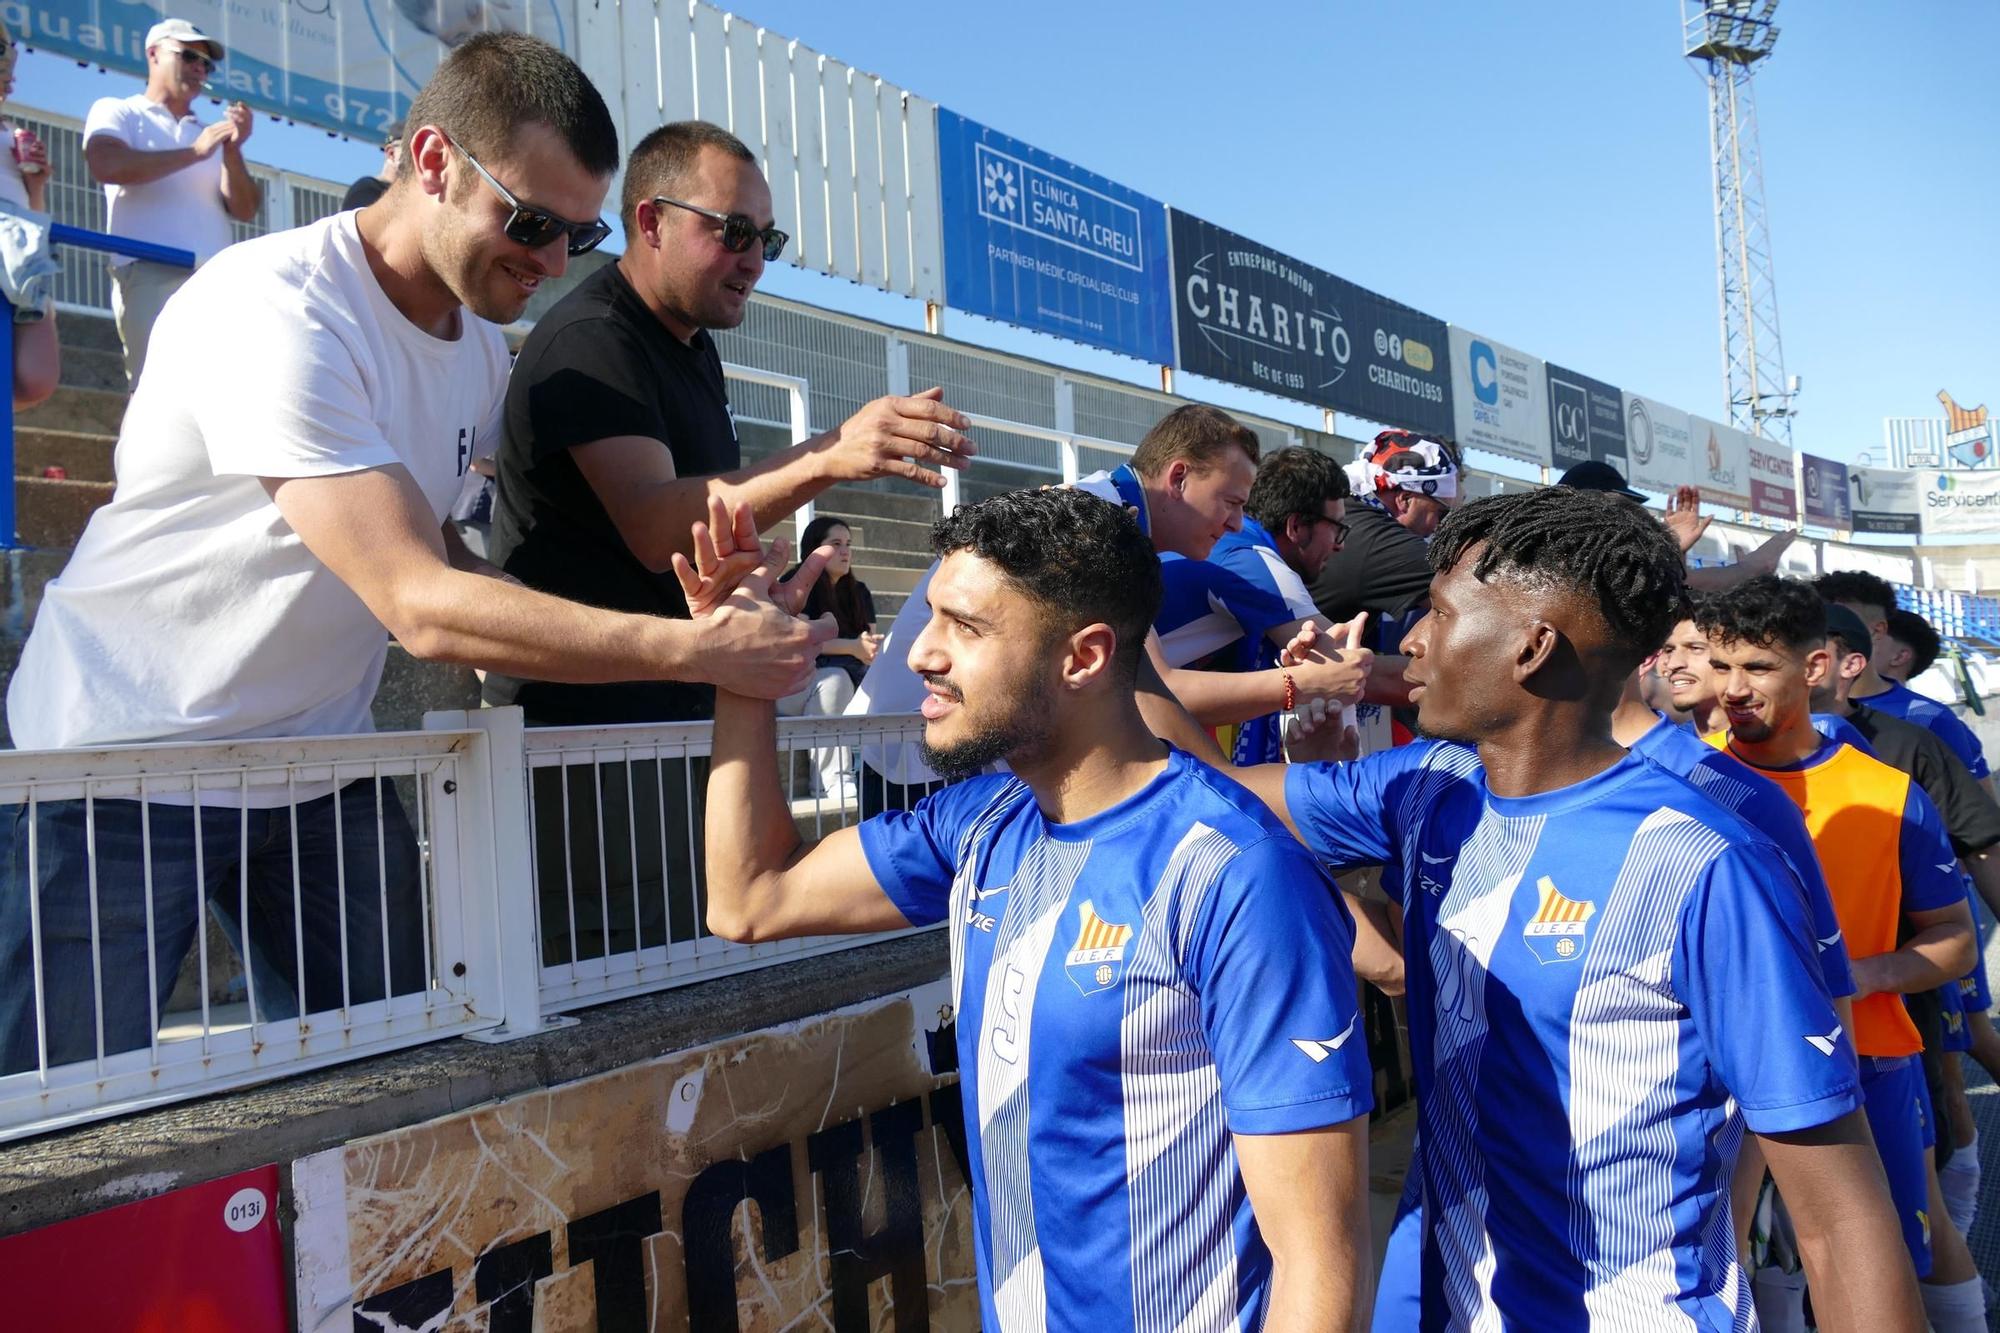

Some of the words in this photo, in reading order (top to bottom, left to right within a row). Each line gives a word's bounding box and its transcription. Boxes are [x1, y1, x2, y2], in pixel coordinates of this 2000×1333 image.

[1, 1, 142, 62] quali
[231, 200, 260, 221] 013i
[1032, 179, 1079, 210] CLÍNICA
[1033, 201, 1090, 241] SANTA
[1093, 224, 1133, 256] CREU
[988, 243, 1035, 271] PARTNER
[1067, 270, 1100, 292] OFICIAL
[1101, 282, 1118, 298] DEL
[1119, 287, 1139, 304] CLUB
[1227, 251, 1277, 274] ENTREPANS
[1279, 264, 1314, 297] D'AUTOR
[1187, 274, 1351, 364] CHARITO
[1253, 361, 1269, 380] DES
[1272, 368, 1282, 384] DE
[1285, 372, 1304, 389] 1953
[1368, 364, 1443, 403] CHARITO1953
[1557, 402, 1585, 442] GC
[1927, 490, 2000, 508] Servicent
